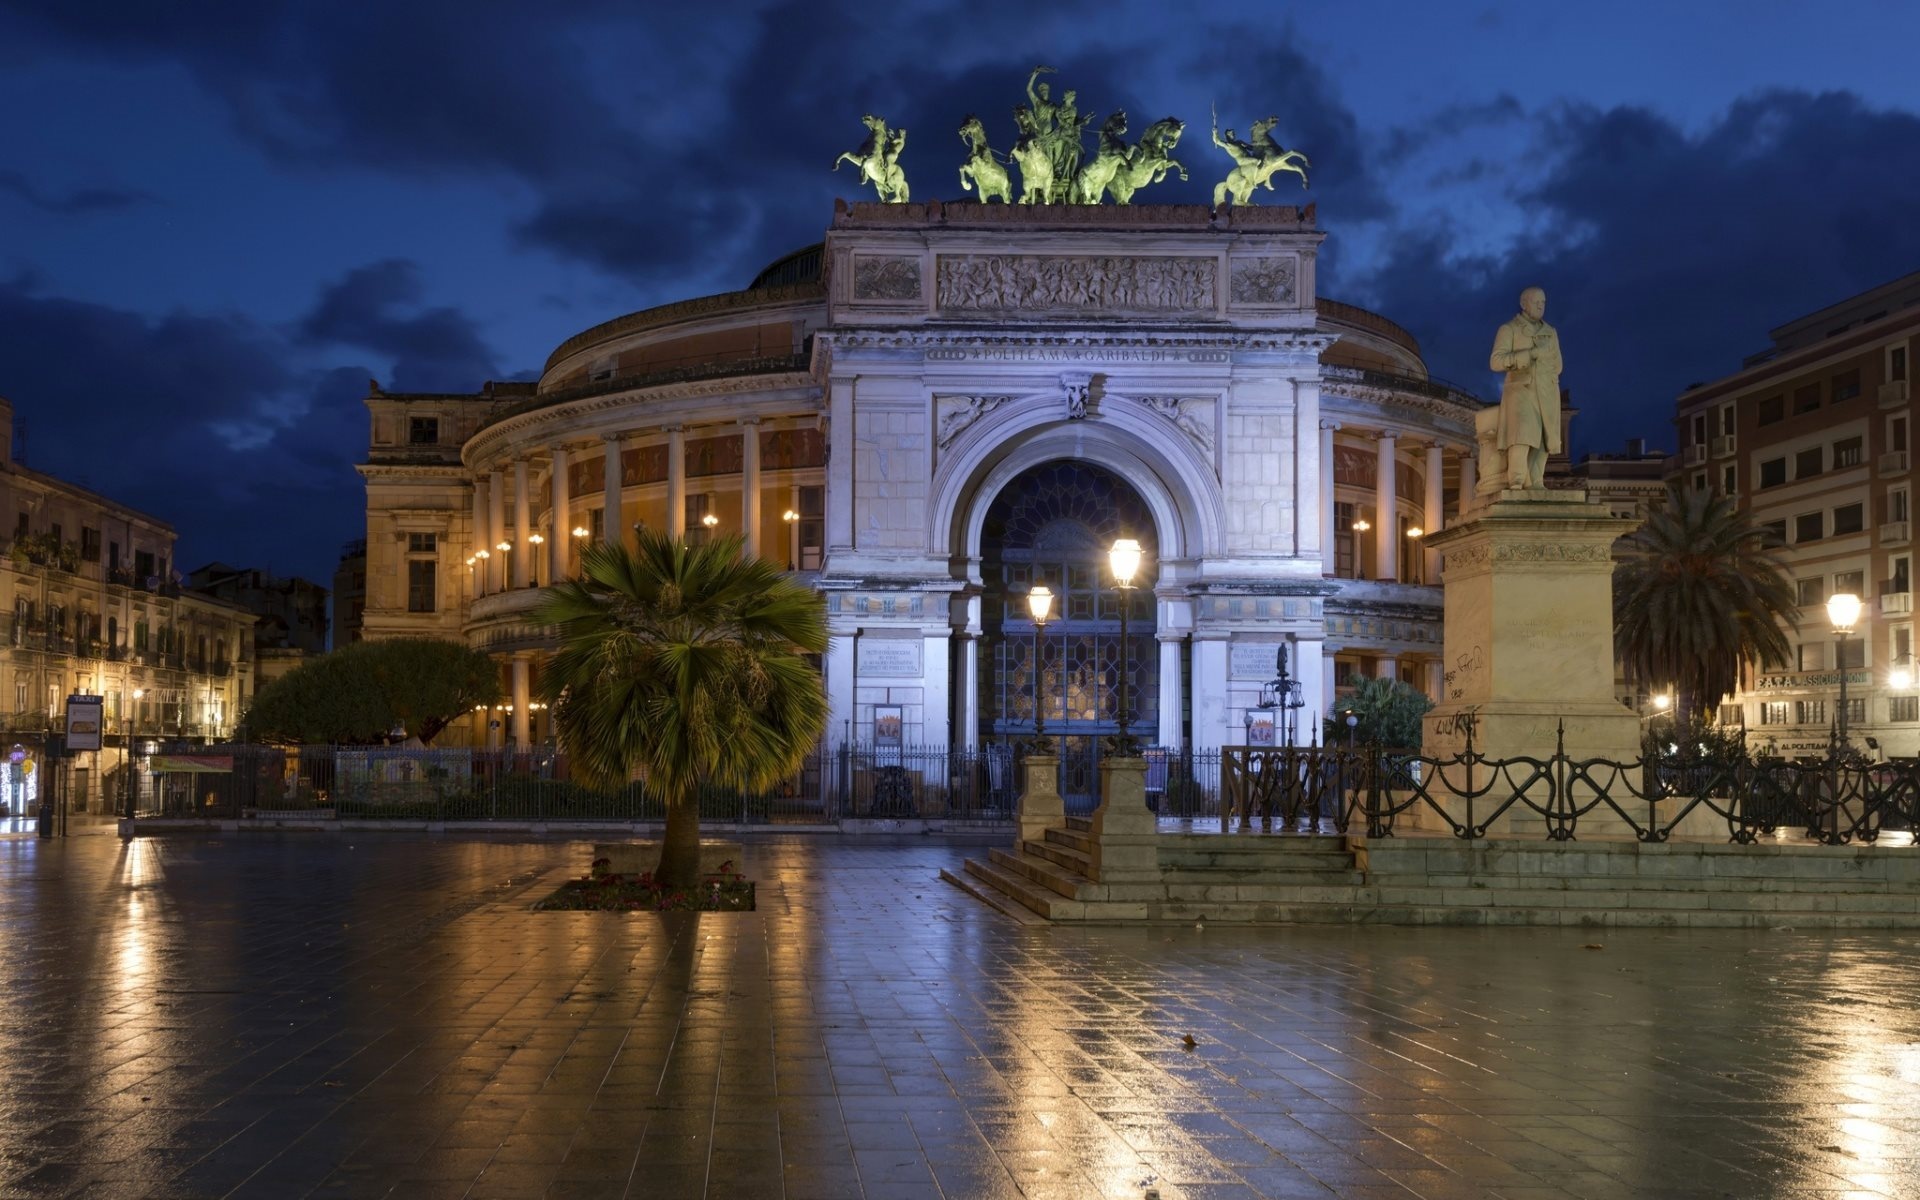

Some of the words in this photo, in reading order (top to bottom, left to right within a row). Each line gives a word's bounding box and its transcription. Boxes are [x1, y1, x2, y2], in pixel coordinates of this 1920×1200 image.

[984, 349, 1071, 361] POLITEAMA
[1084, 350, 1165, 361] GARIBALDI
[1803, 672, 1867, 687] ASSICURAIONI
[74, 695, 96, 703] TAXI
